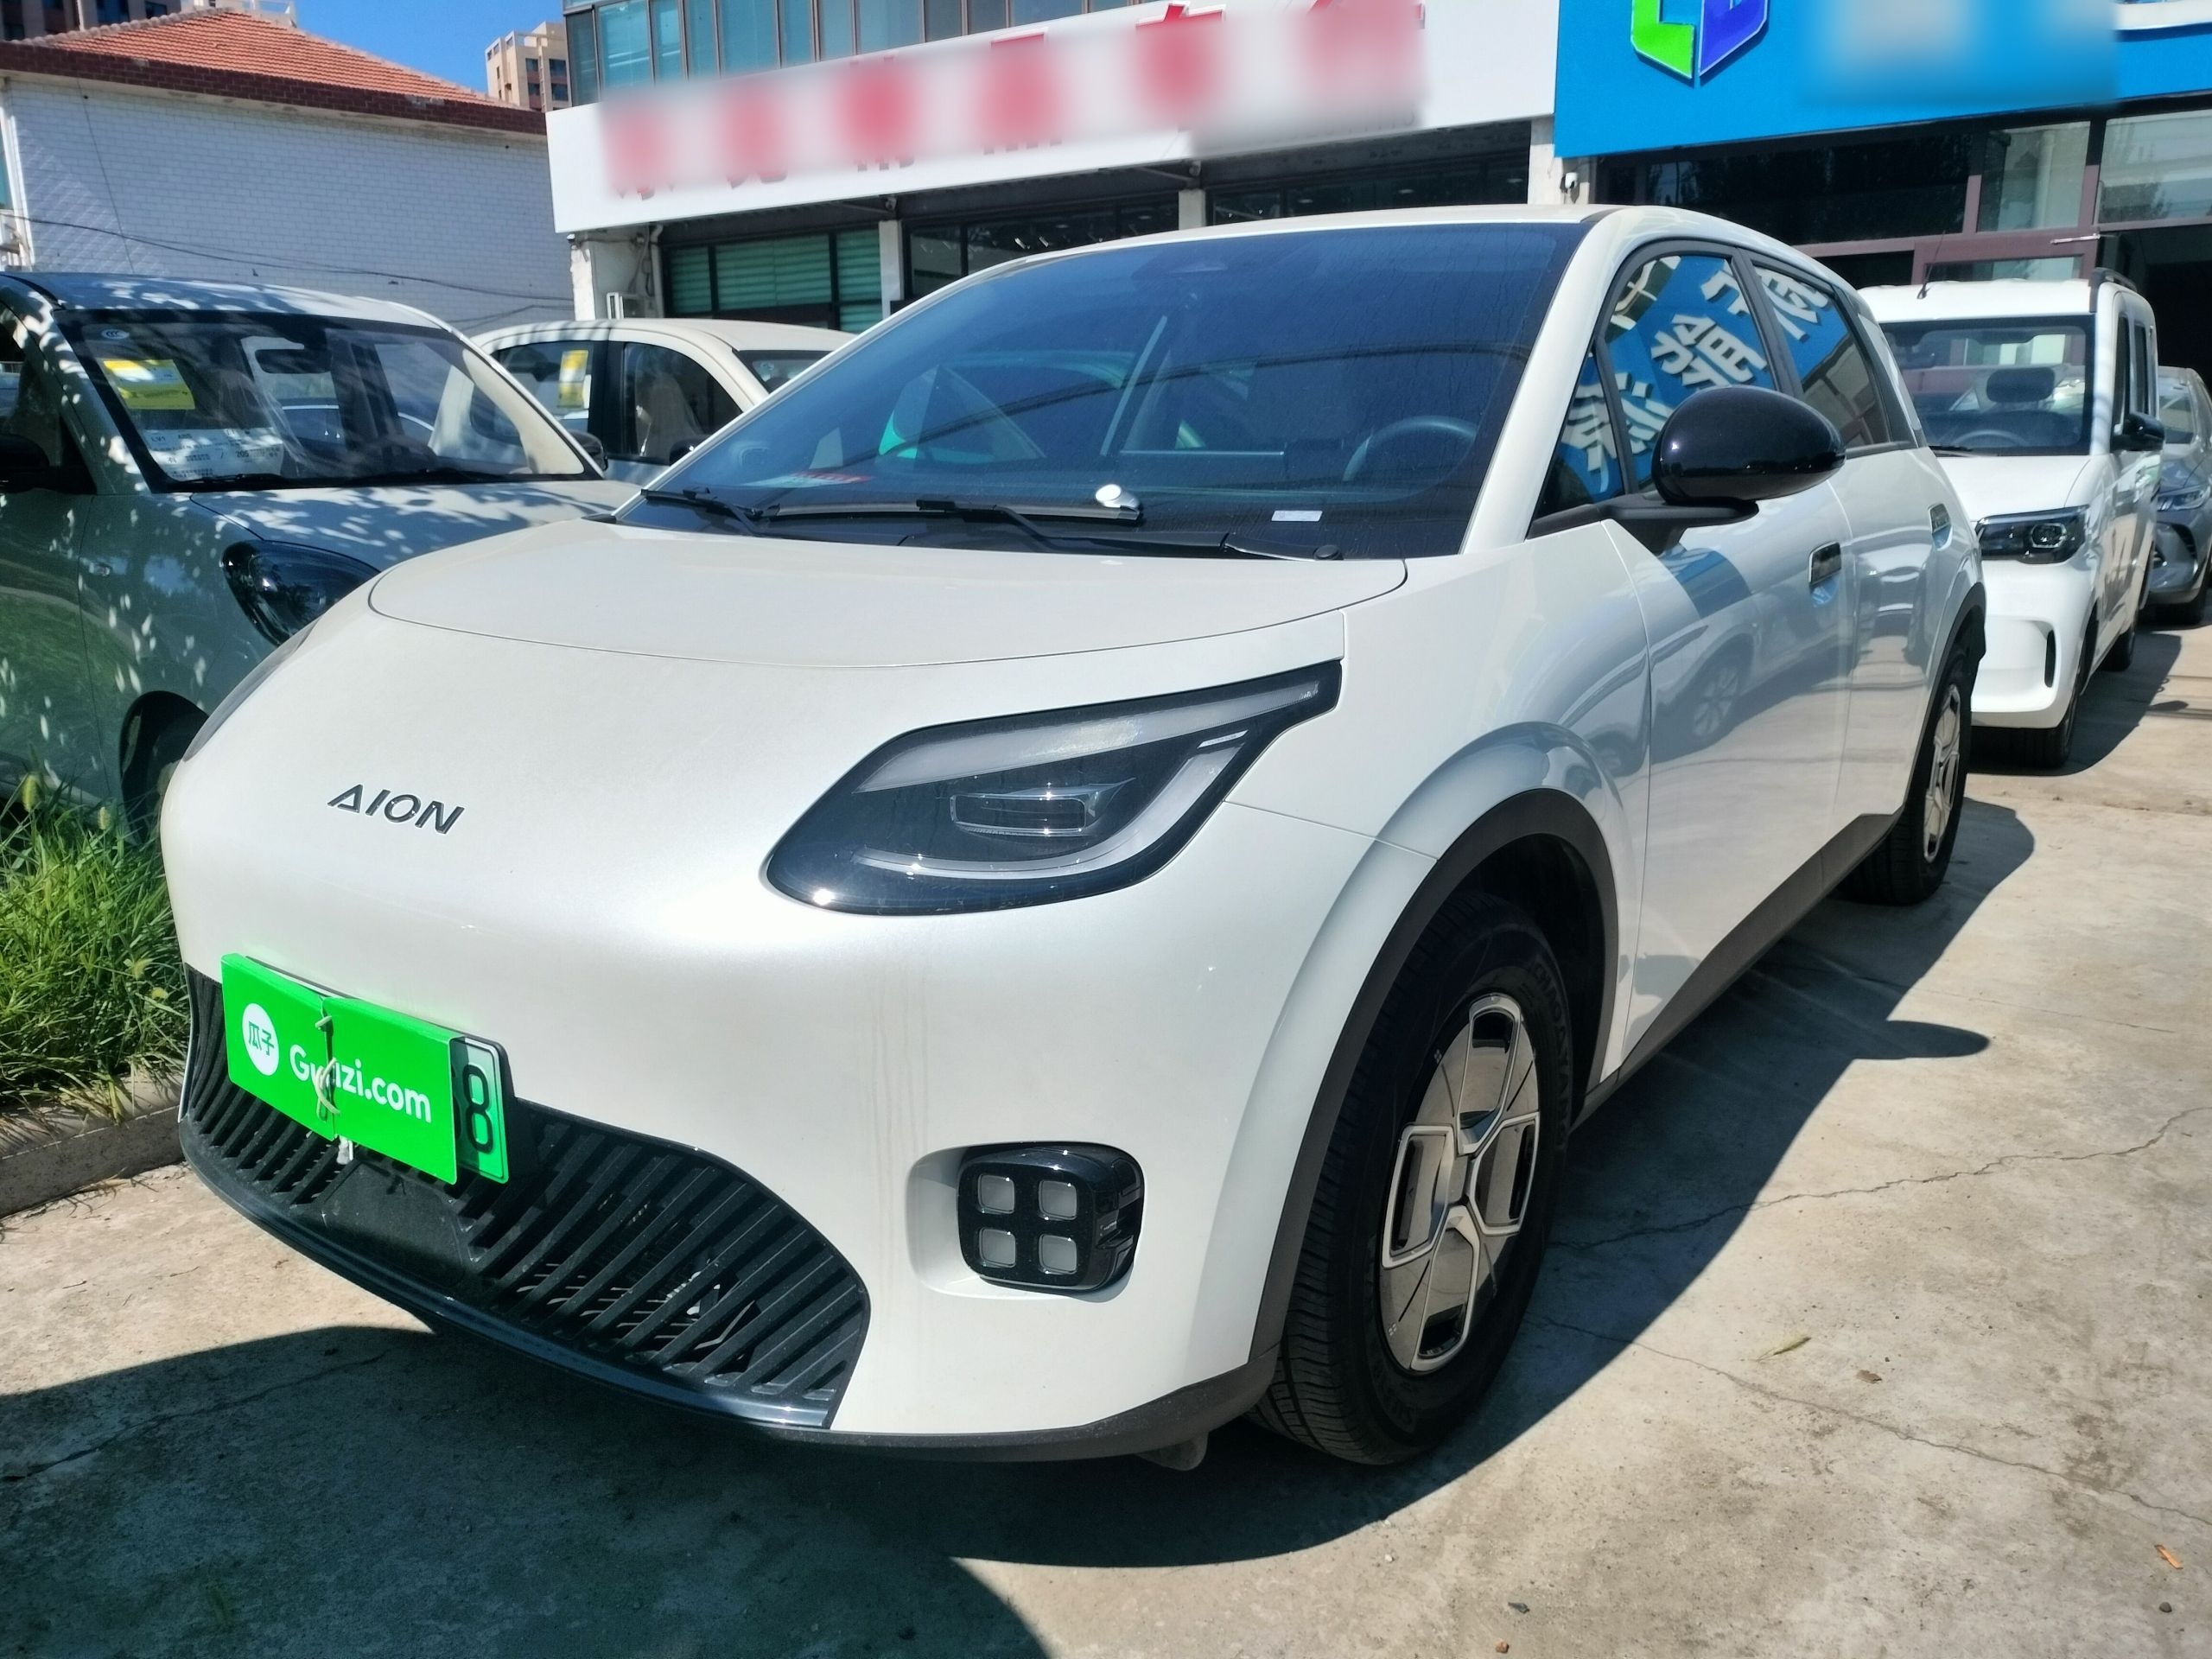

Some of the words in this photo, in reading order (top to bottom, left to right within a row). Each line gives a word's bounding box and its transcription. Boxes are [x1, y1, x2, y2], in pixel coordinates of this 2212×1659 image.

[327, 784, 465, 835] AION
[248, 1020, 275, 1057] 瓜子
[451, 1063, 494, 1155] 8
